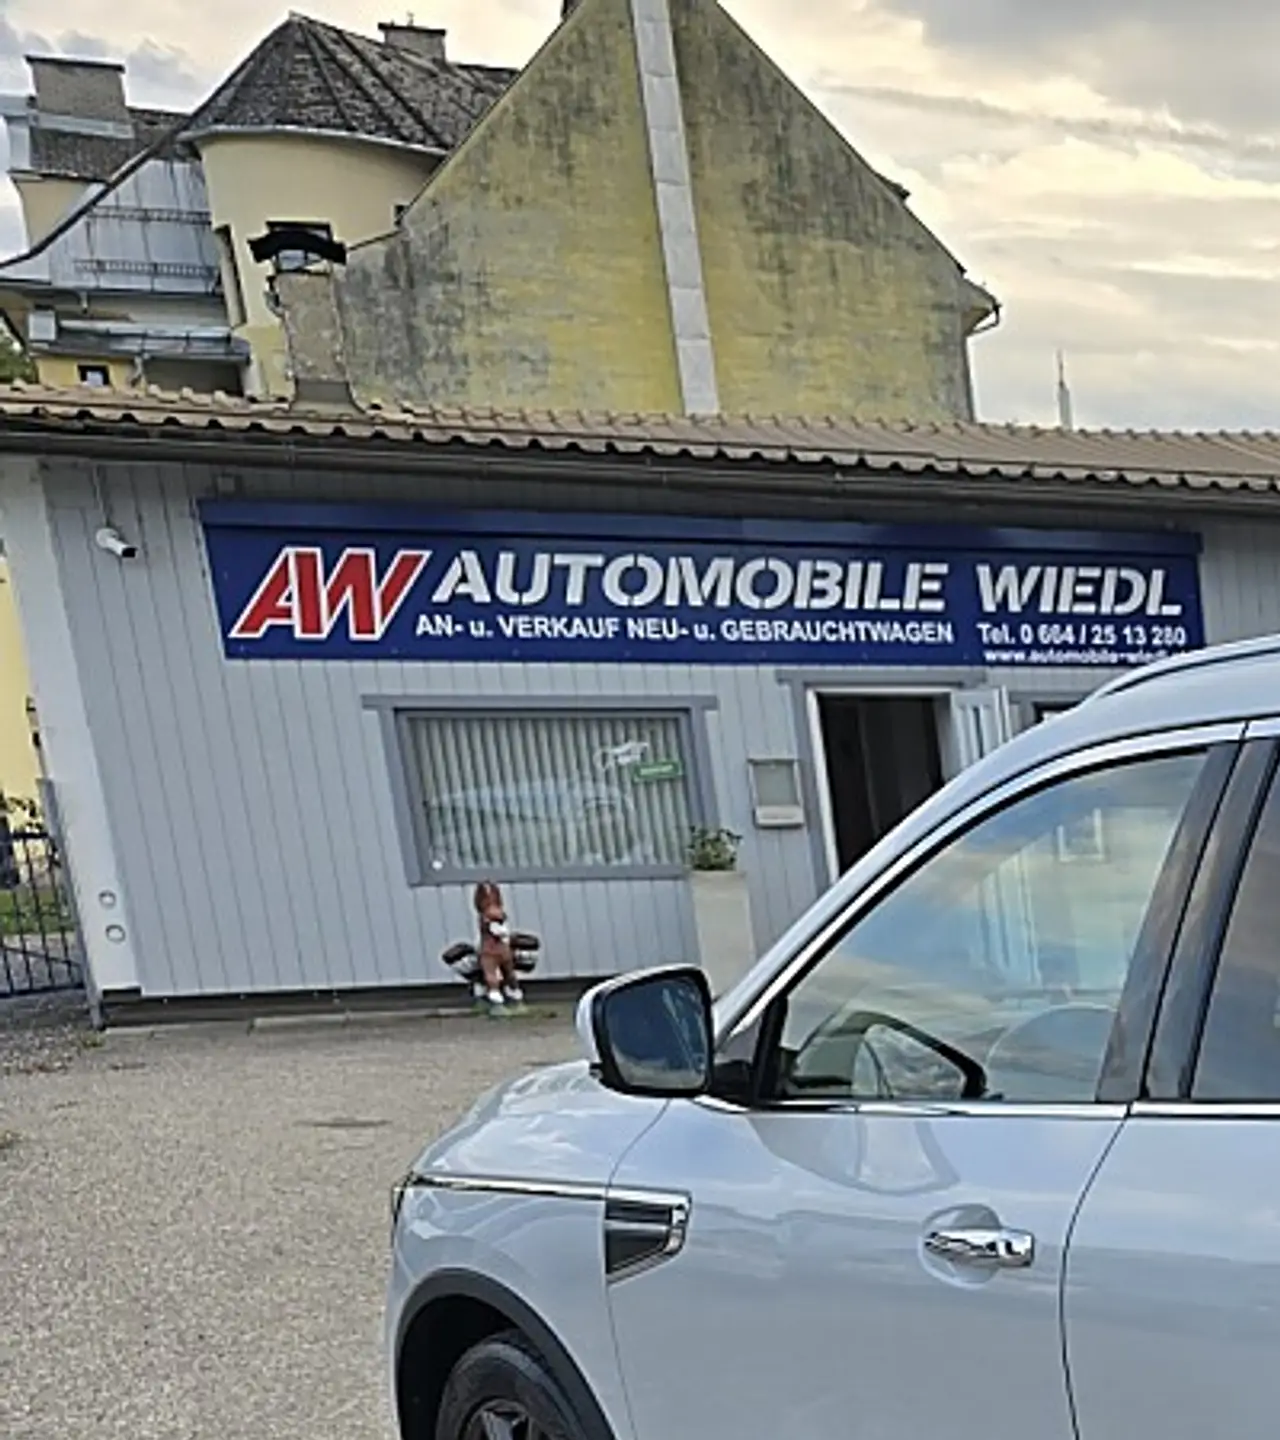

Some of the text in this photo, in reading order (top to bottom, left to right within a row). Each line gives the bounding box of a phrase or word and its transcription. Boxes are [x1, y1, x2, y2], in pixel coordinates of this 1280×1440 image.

[228, 548, 432, 640] AW
[431, 550, 1183, 617] AUTOMOBILE WIEDL
[415, 614, 953, 644] AN- u. VERKAUF NEU- u. GEBRAUCHTWAGEN
[976, 623, 1016, 645] Tel.
[1020, 624, 1034, 645] 0
[1078, 624, 1088, 645] /
[1090, 625, 1118, 645] 25
[1123, 626, 1147, 646] 13
